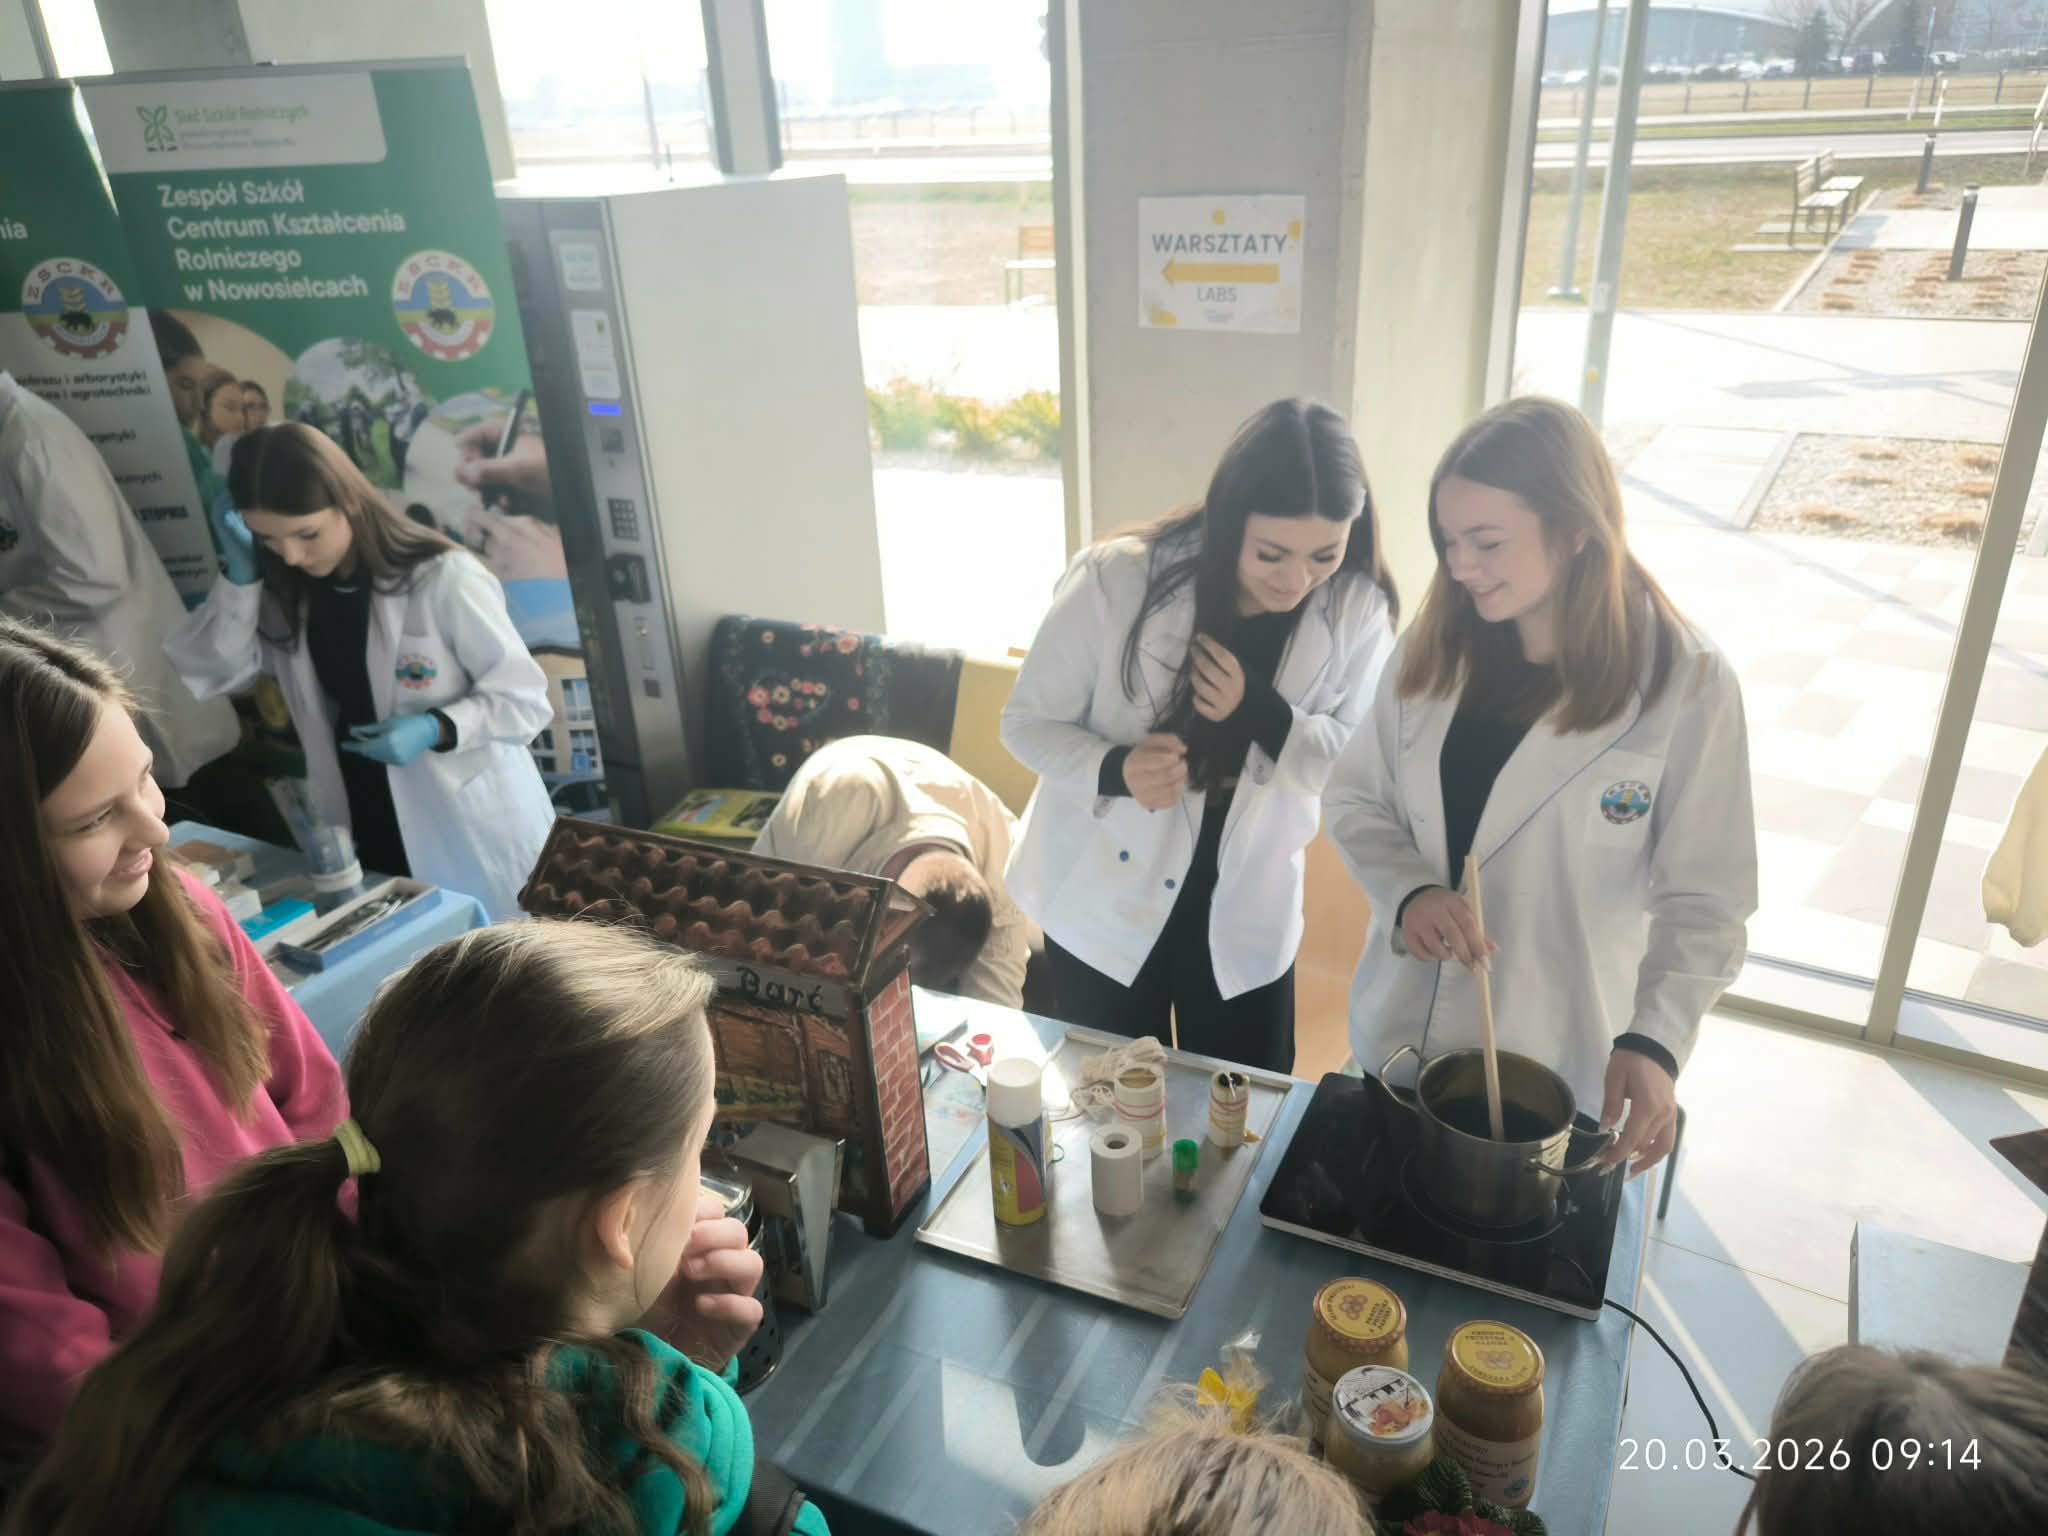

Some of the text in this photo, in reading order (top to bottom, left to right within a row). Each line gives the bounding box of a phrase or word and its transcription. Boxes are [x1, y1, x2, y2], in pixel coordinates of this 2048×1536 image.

[157, 179, 304, 210] Zespół Szkół
[167, 209, 406, 239] Centrum Kształcenia
[1152, 233, 1288, 254] WARSZTATY
[175, 247, 302, 272] Rolniczego
[184, 275, 368, 302] w Nowosielcach
[1196, 287, 1238, 303] LABS
